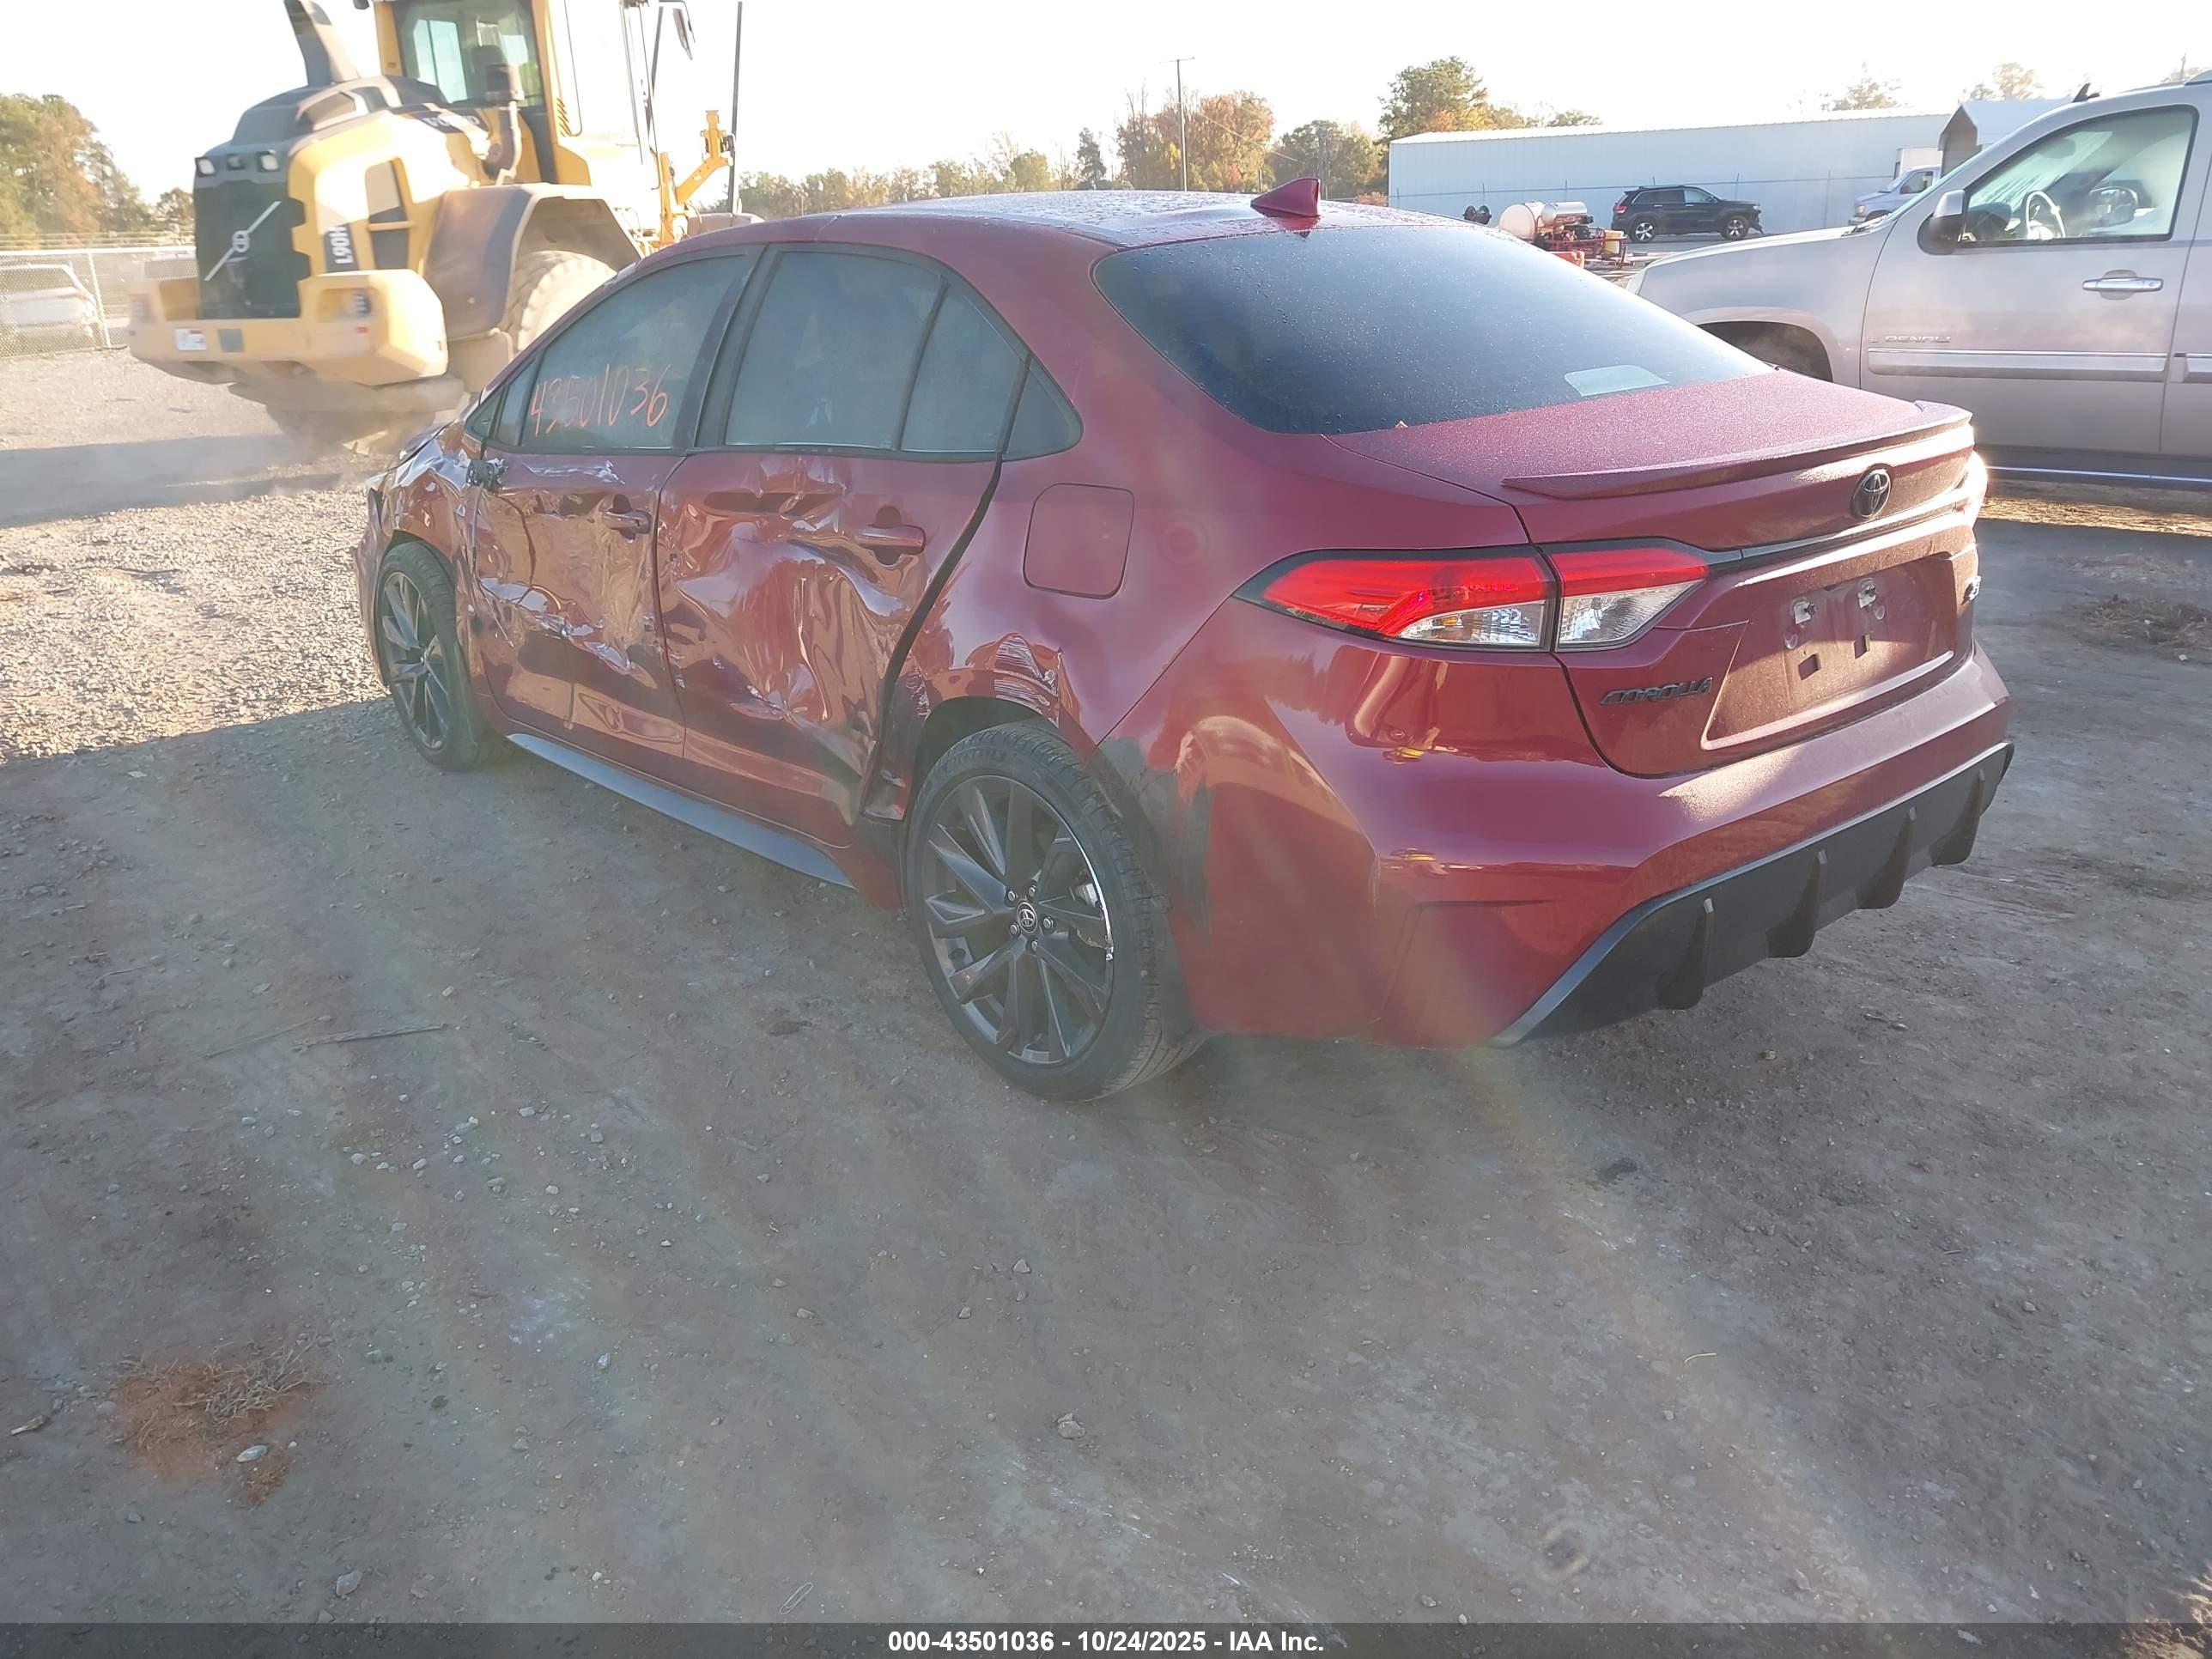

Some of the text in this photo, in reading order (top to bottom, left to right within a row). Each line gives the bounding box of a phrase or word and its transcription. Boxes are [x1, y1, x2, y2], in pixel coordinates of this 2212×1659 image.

[329, 226, 354, 264] L90H
[1885, 335, 1951, 343] DENALI
[530, 363, 672, 438] 43501036
[1601, 677, 1713, 706] COROLLA
